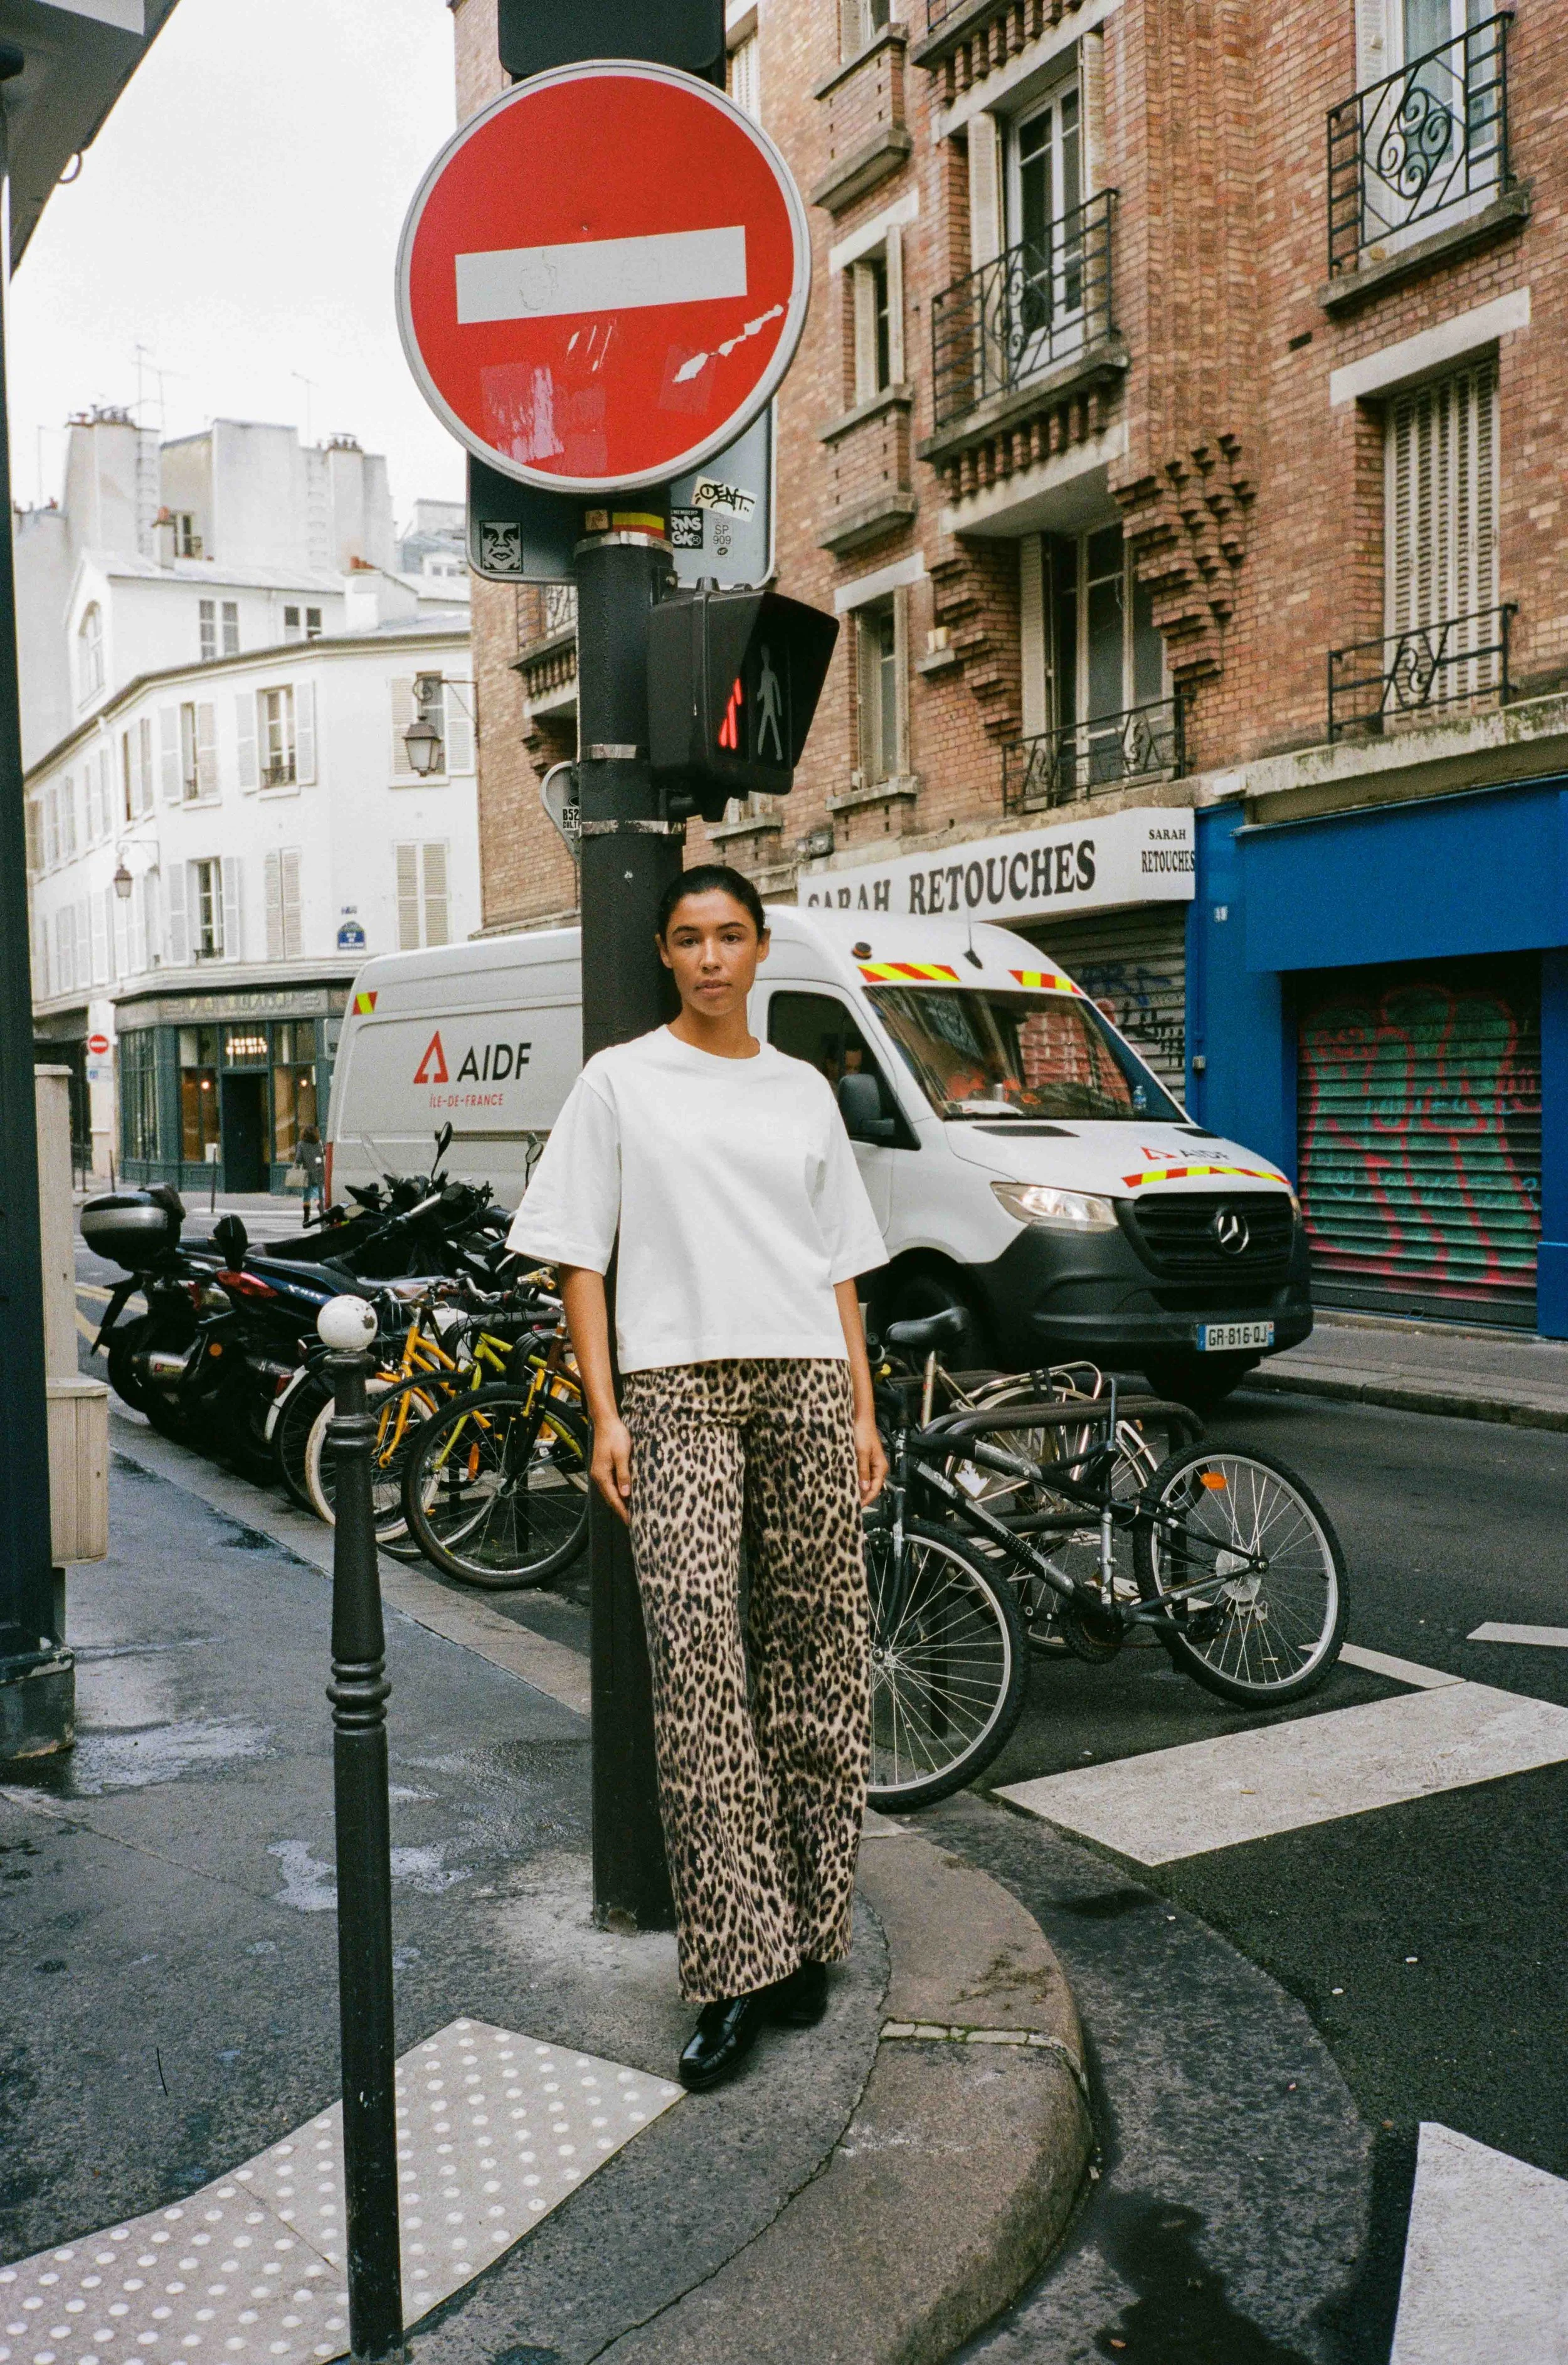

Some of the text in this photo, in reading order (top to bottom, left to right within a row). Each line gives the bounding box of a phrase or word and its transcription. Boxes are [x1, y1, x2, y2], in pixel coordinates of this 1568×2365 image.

[715, 524, 729, 534] SP
[713, 535, 731, 545] 909
[1149, 829, 1186, 840] SARAH
[1142, 850, 1195, 873] RETOUCHES
[909, 839, 1096, 915] RETOUCHES
[457, 1042, 532, 1082] AIDF
[1209, 1326, 1268, 1346] GR-816-QJ
